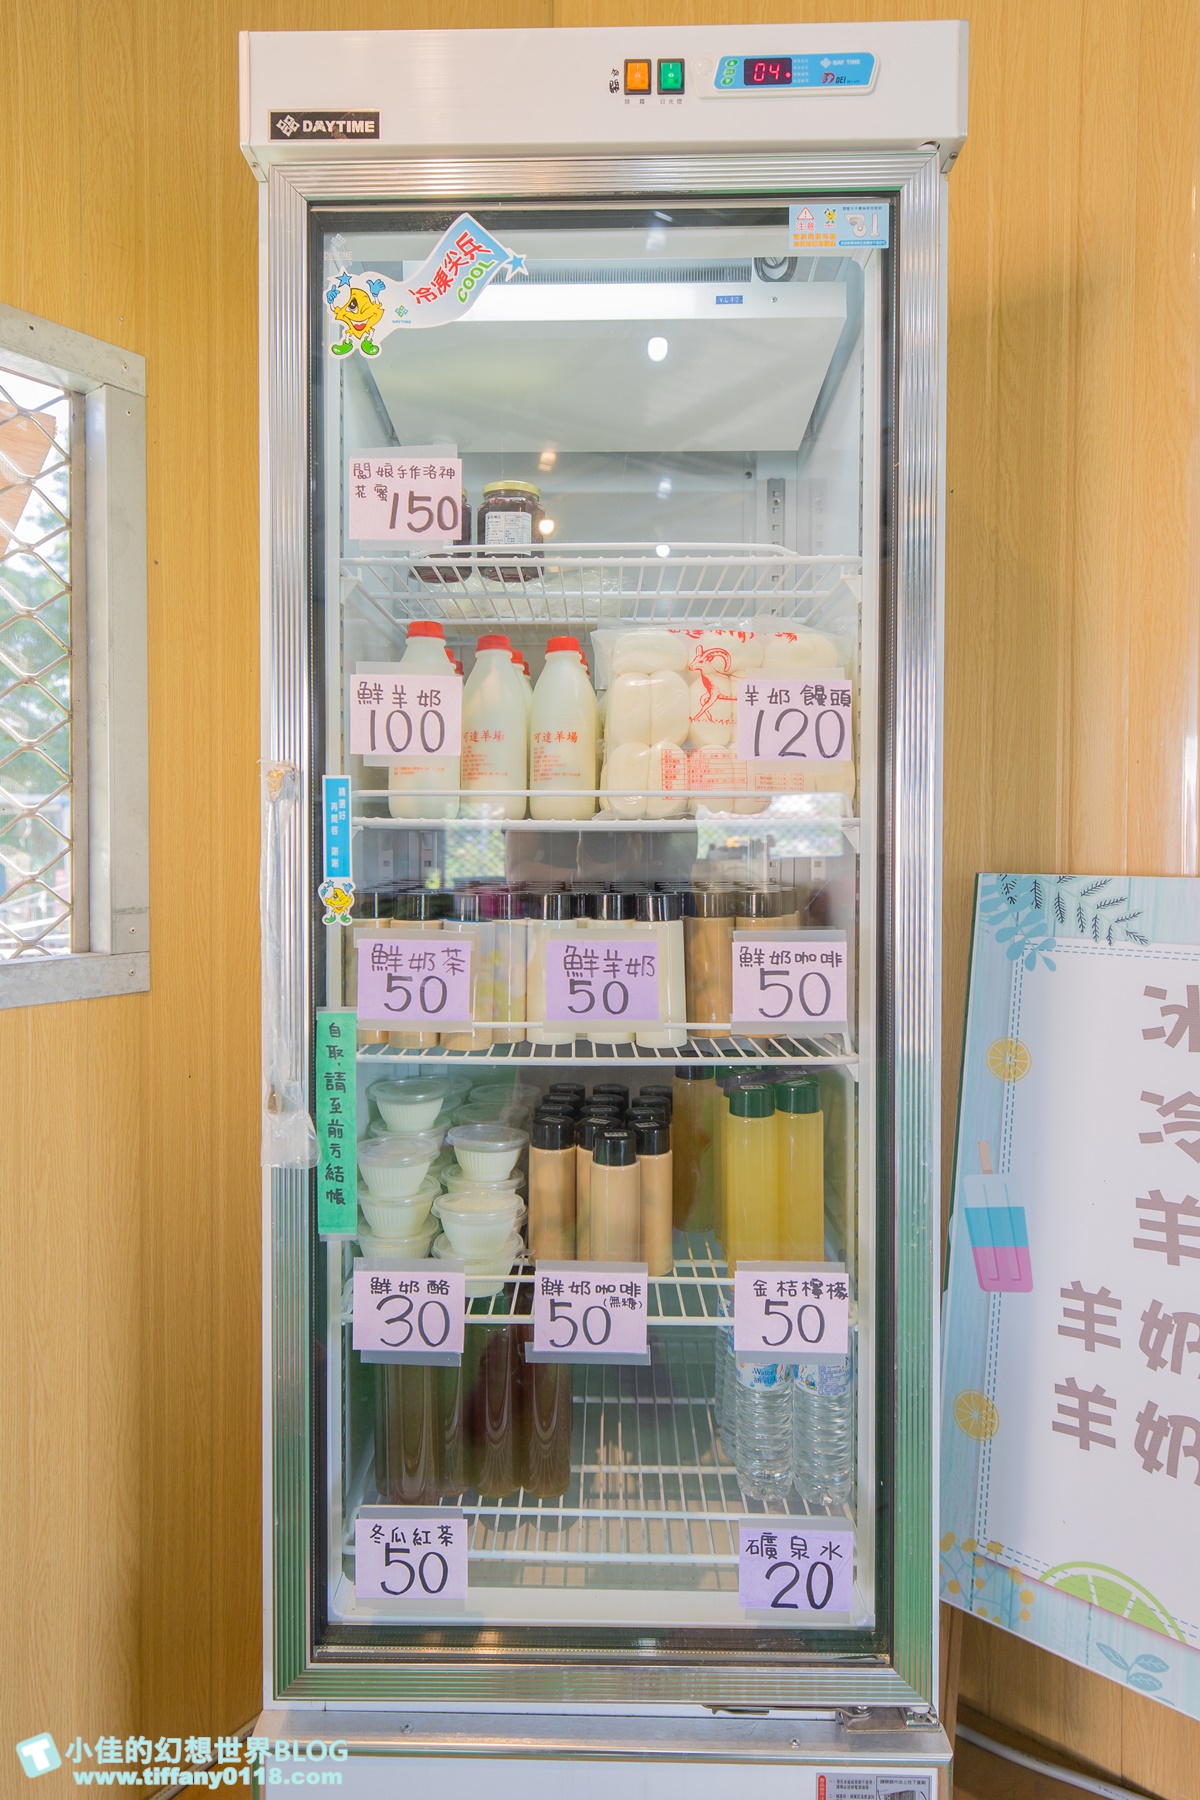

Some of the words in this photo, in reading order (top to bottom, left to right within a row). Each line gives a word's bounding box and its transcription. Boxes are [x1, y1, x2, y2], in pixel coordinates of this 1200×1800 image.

[753, 62, 780, 82] 04
[302, 119, 375, 134] DAYTIME
[796, 221, 815, 231] 注意
[408, 231, 492, 305] 冷凍尖兵
[457, 260, 495, 303] COOL
[389, 490, 459, 533] 150
[357, 681, 441, 709] 鮮羊奶
[745, 684, 851, 708] 羊奶饅頭
[369, 709, 446, 753] 100
[754, 708, 846, 759] 120
[371, 942, 466, 976] 鮮奶茶
[563, 944, 656, 979] 鮮羊奶
[739, 946, 843, 968] 鮮奶咖啡
[384, 972, 447, 1014] 50
[567, 978, 629, 1015] 50
[758, 967, 831, 1018] 50
[1133, 1189, 1200, 1267] 羊
[370, 1276, 450, 1296] 鮮奶酪
[541, 1276, 641, 1298] 鮮奶咖啡
[376, 1294, 450, 1347] 30
[549, 1298, 611, 1348] 50
[761, 1298, 825, 1346] 50
[370, 1523, 453, 1547] 冬瓜紅茶
[745, 1532, 843, 1561] 礦泉水
[380, 1542, 449, 1595] 50
[765, 1561, 834, 1610] 20
